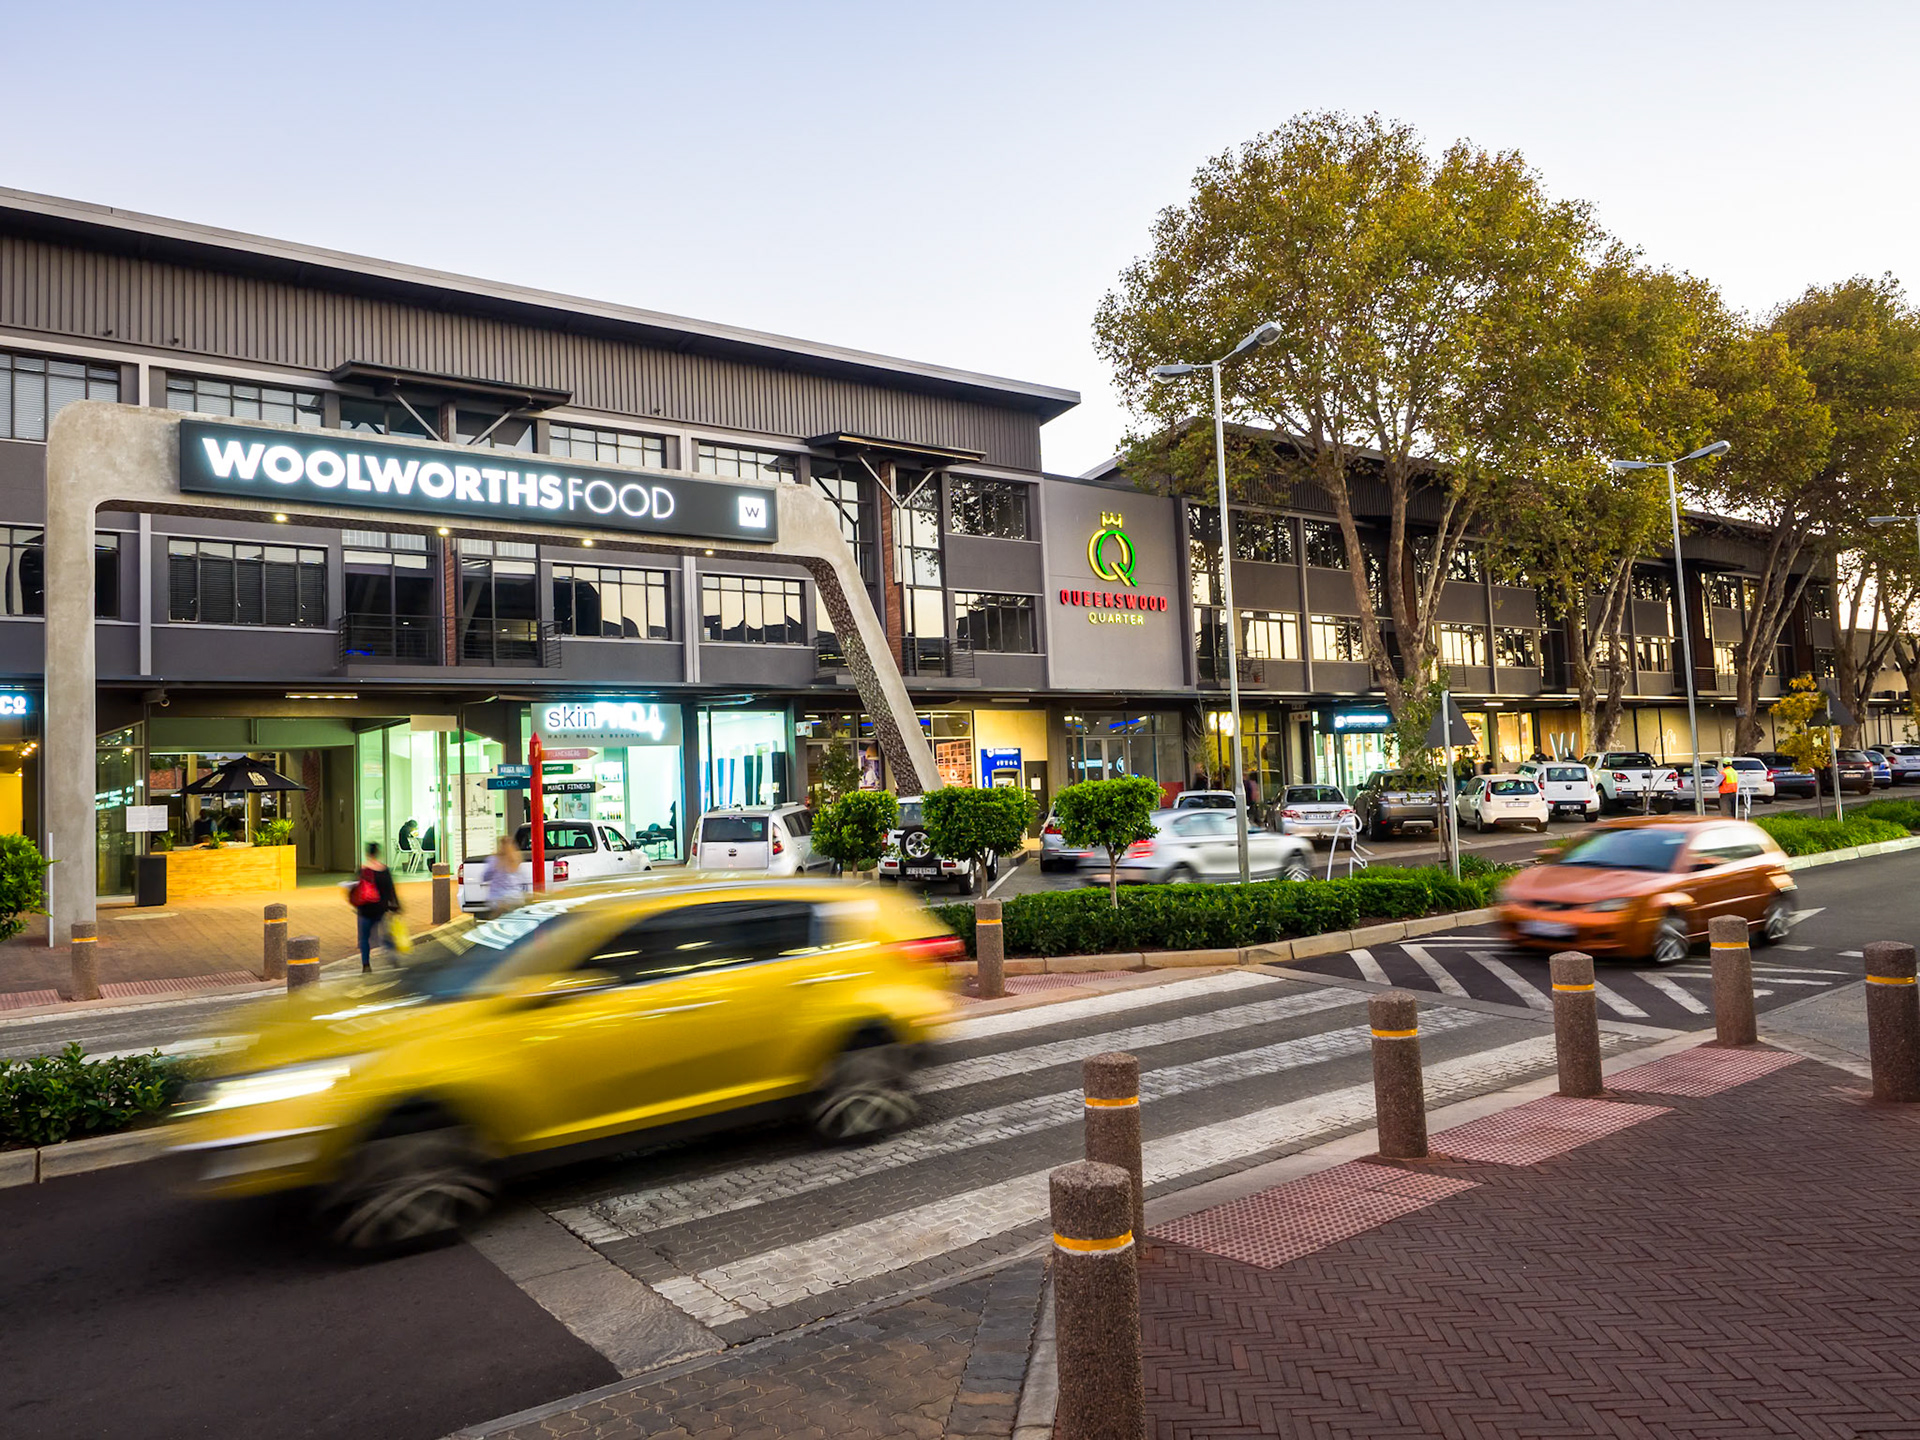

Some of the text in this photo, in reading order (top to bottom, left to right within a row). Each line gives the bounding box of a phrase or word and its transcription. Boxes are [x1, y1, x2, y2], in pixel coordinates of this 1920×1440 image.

[202, 437, 675, 520] WOOLWORTHS FOOD
[745, 505, 761, 519] W
[1060, 589, 1168, 612] QUEENSWOOD
[1088, 611, 1144, 625] QUARTER
